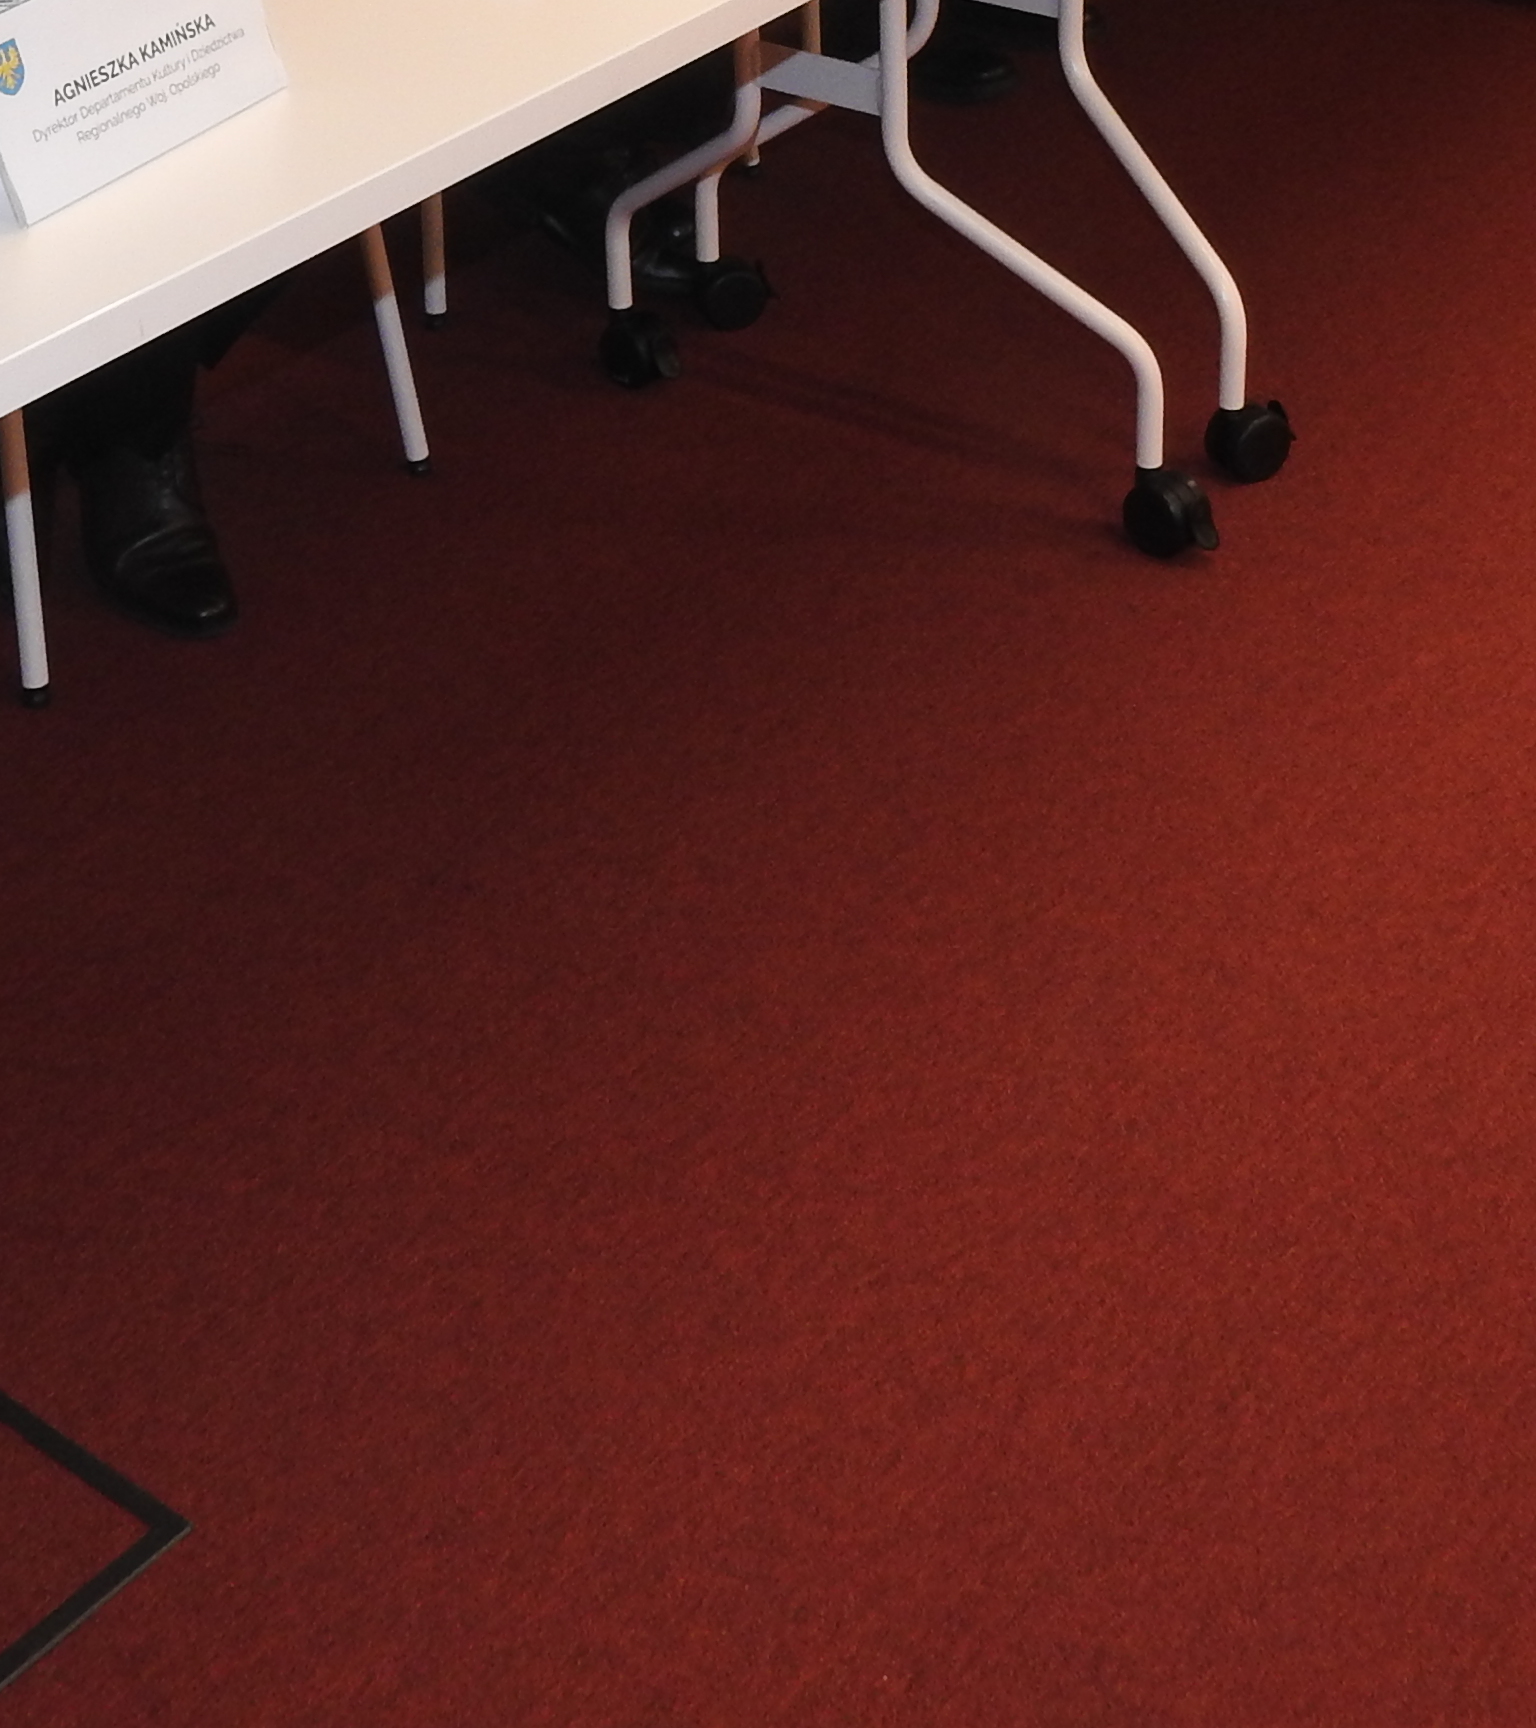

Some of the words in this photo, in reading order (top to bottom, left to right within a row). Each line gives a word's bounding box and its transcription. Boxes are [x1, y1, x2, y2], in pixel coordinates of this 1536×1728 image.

[32, 112, 78, 143] Dyrektor
[79, 77, 152, 120] Departamentu
[151, 58, 186, 85] Kultury
[191, 27, 246, 63] Dziedzictwa
[53, 51, 140, 106] AGNIESZKA
[139, 13, 216, 63] KAMIŃSKA
[76, 101, 147, 144] Regionalnego
[168, 62, 221, 96] Opolskiego
